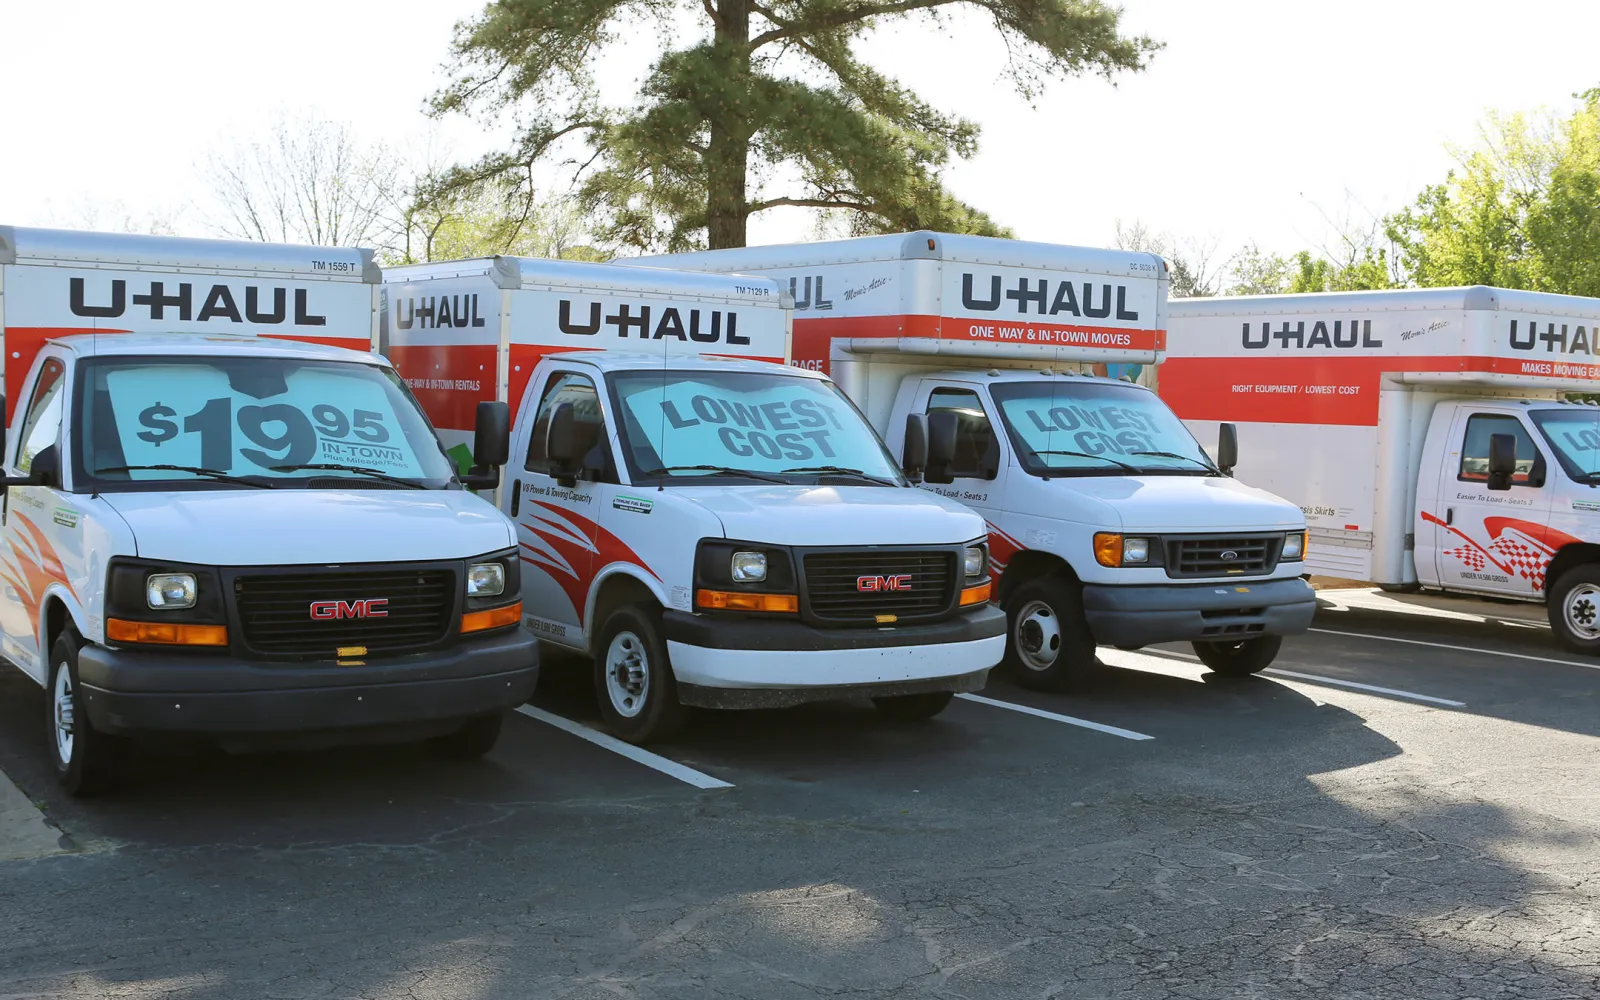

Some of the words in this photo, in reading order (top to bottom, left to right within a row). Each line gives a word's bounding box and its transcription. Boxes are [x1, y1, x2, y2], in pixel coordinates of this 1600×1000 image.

[312, 260, 326, 270] TM
[328, 261, 348, 272] 1559
[350, 262, 356, 272] T
[69, 277, 326, 326] U-HAUL
[735, 286, 746, 295] TM
[747, 287, 763, 296] 7129
[764, 288, 769, 297] R
[962, 273, 1139, 321] U-HAUL
[397, 293, 486, 330] U-HAUL
[558, 299, 751, 346] U-HAUL
[969, 324, 995, 339] ONE
[998, 326, 1025, 340] WAY
[1027, 328, 1036, 341] &
[1038, 329, 1090, 344] IN-TOWN
[1091, 332, 1131, 346] MOVES
[1242, 319, 1383, 349] U-HAUL
[1400, 328, 1426, 342] Mom's
[1521, 362, 1551, 375] MAKES
[1553, 365, 1587, 377] MOVING
[1588, 366, 1600, 378] EA
[426, 379, 431, 389] &
[431, 379, 454, 390] IN-TOWN
[455, 380, 480, 391] RENTALS
[1231, 384, 1253, 394] RIGHT
[1255, 384, 1298, 394] EQUIPMENT
[1305, 385, 1336, 394] LOWEST
[1338, 385, 1360, 395] COST
[659, 394, 844, 431] LOWEST
[1025, 405, 1162, 434] LOWEST
[717, 426, 837, 461] COST
[1073, 430, 1160, 456] COST
[1562, 428, 1600, 452] LO
[321, 442, 404, 461] IN-TOWN
[323, 453, 345, 462] Plus
[522, 482, 530, 493] V8
[529, 484, 546, 495] Power
[545, 486, 550, 496] &
[551, 487, 569, 501] Towing
[568, 491, 593, 505] Capacity
[935, 487, 943, 496] To
[943, 488, 959, 498] Load
[963, 491, 982, 501] Seats
[982, 493, 988, 502] 3
[1456, 492, 1476, 501] Easier
[1478, 494, 1485, 502] To
[1486, 495, 1503, 503] Load
[1508, 497, 1527, 506] Seats
[1315, 506, 1336, 517] Skirts
[857, 574, 912, 592] GMC
[309, 598, 389, 620] GMC
